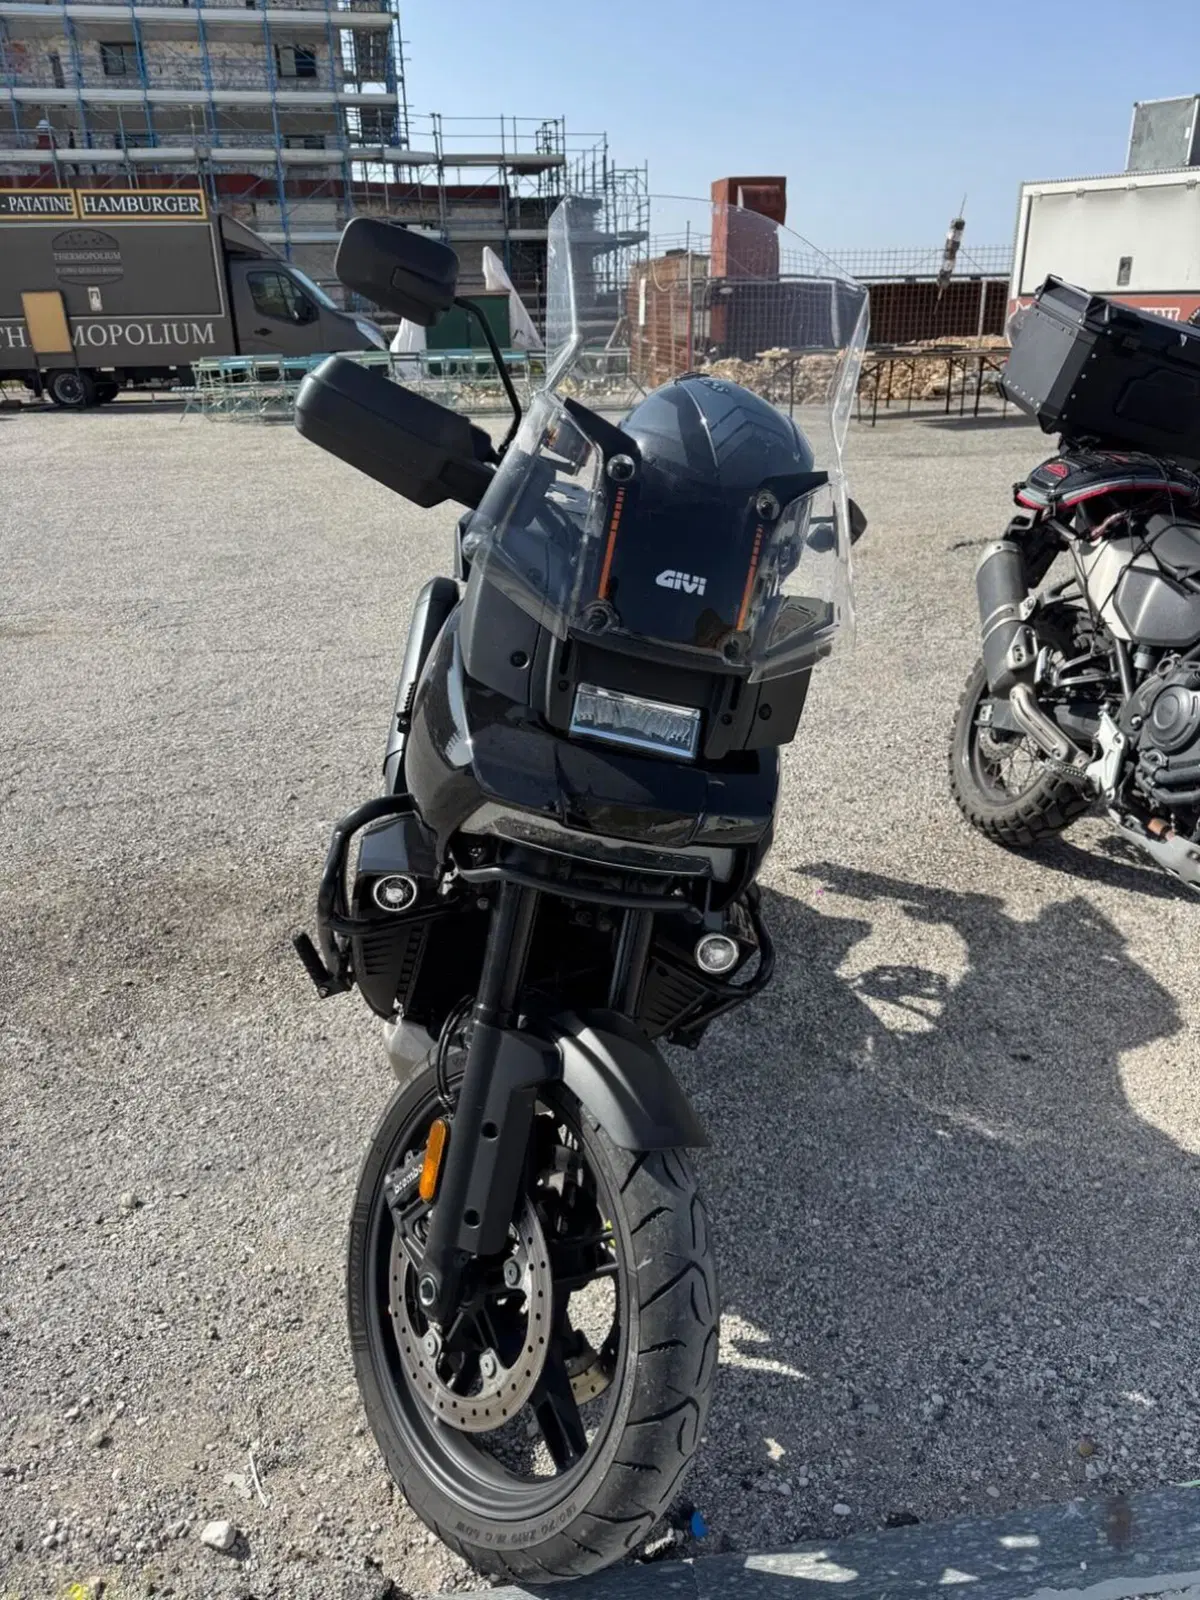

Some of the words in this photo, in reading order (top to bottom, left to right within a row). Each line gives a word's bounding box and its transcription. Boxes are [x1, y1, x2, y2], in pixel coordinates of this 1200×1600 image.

[8, 196, 73, 212] PATATINE
[83, 196, 202, 213] HAMBURGER
[0, 322, 215, 348] HMOPOLIUM
